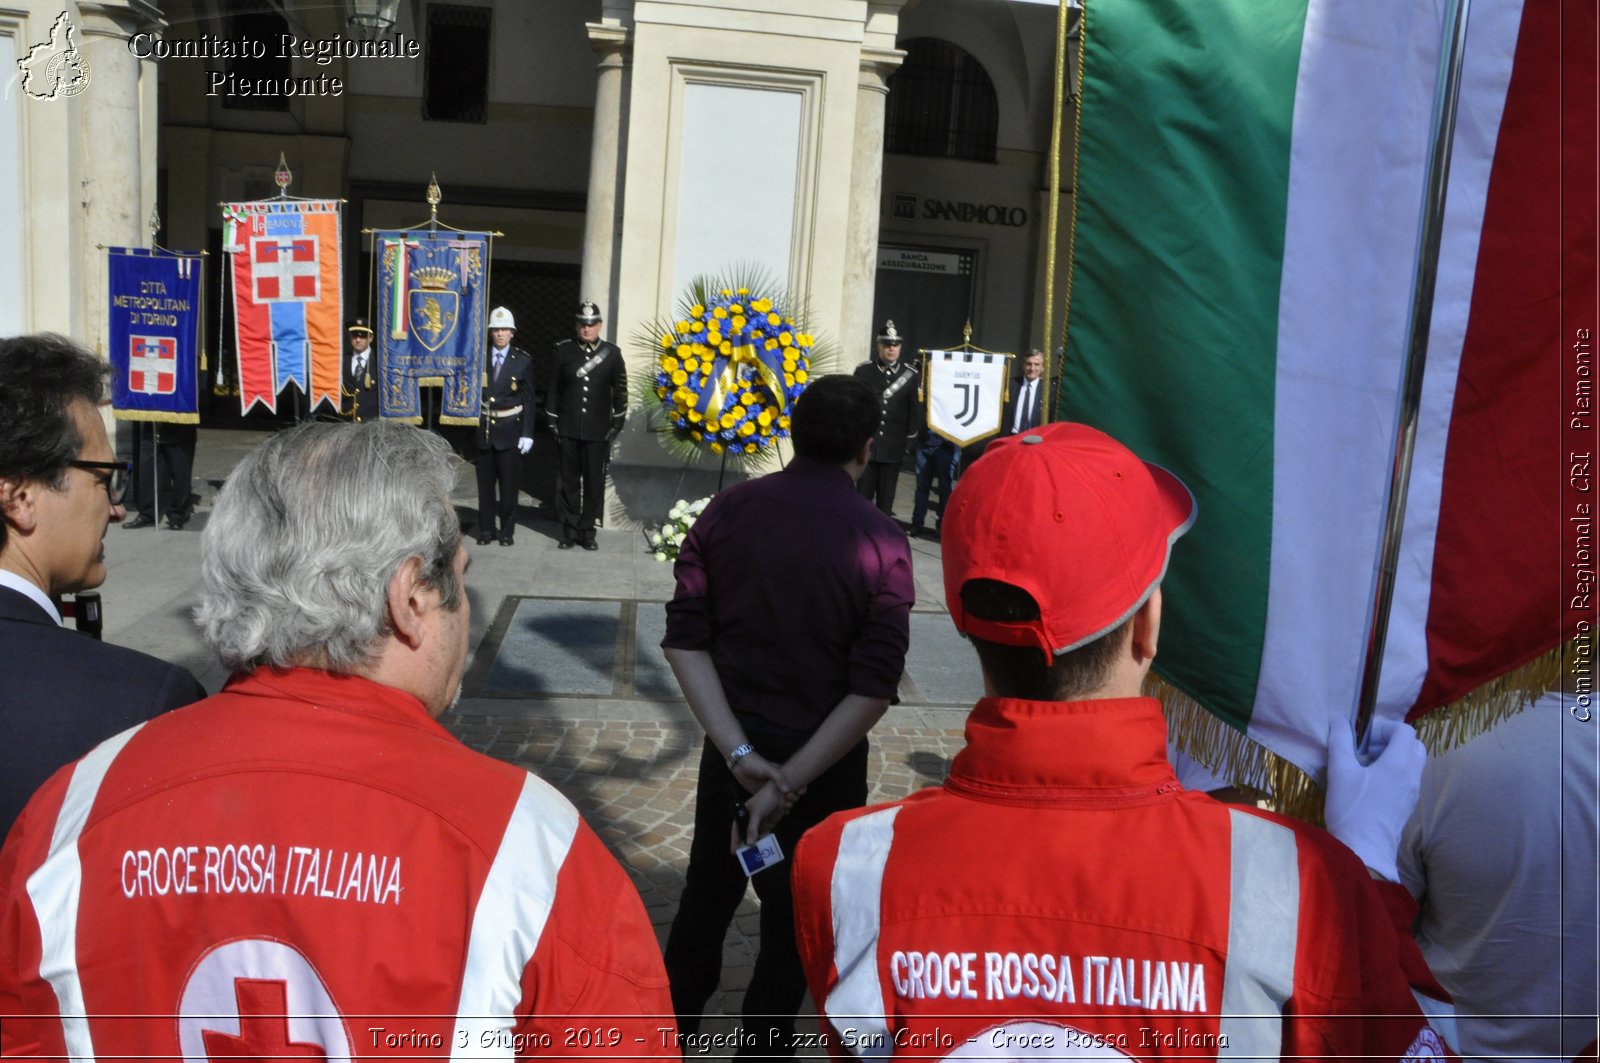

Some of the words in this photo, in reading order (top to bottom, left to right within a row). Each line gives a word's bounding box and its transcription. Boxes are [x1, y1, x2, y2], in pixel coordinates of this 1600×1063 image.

[259, 219, 310, 233] PEMONE
[901, 252, 928, 263] BANCA
[880, 259, 947, 272] ASSICURAZIONE
[130, 311, 140, 325] DI
[141, 312, 178, 327] TORINO
[121, 846, 199, 898] CROCE
[203, 844, 276, 894] ROSSA
[281, 846, 403, 906] ITALIANA
[891, 951, 978, 1000] CROCE
[984, 952, 1076, 1004] ROSSA
[1082, 956, 1207, 1013] ITALIANA
